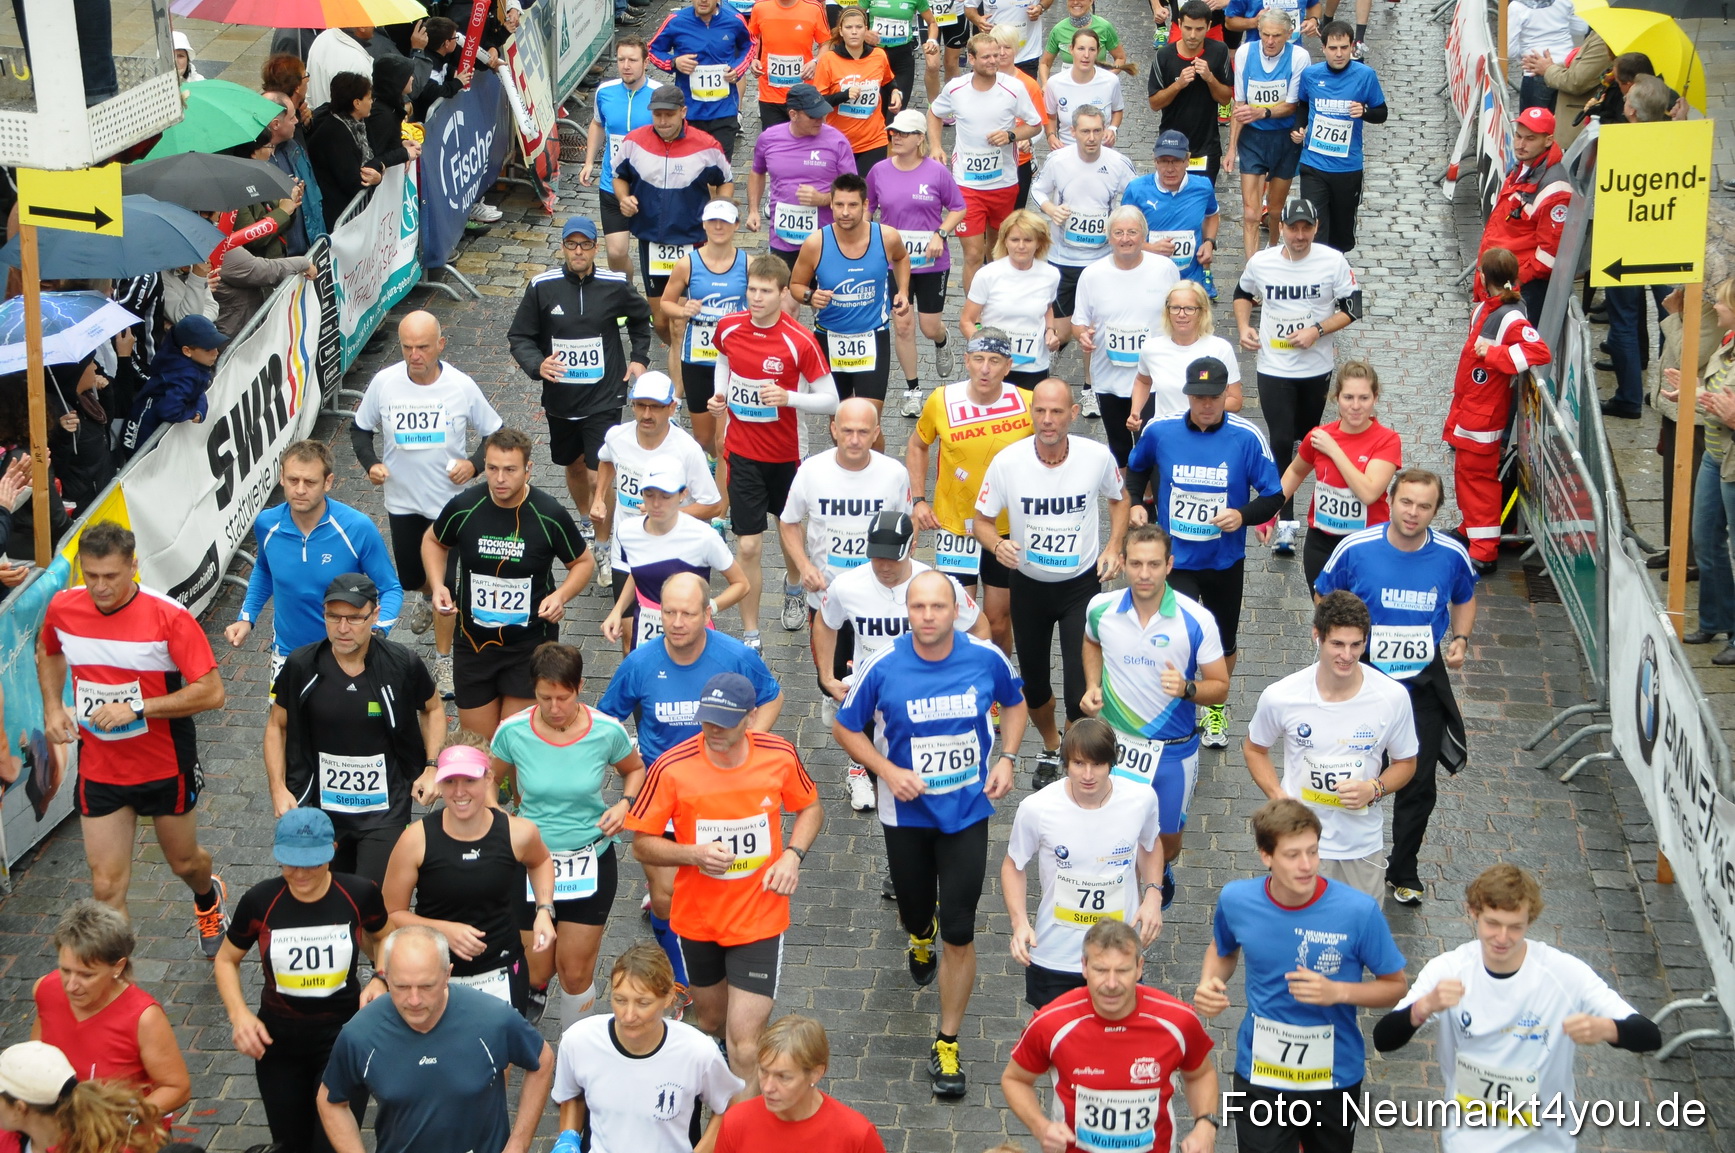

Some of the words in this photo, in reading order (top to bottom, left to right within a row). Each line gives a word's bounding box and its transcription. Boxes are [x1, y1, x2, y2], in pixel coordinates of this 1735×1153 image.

[876, 23, 905, 37] 2113
[465, 35, 476, 57] BKK
[771, 62, 801, 76] 2019
[698, 74, 722, 88] 113
[1254, 89, 1280, 104] 408
[1315, 125, 1348, 143] 2764
[966, 156, 999, 171] 2927
[1600, 165, 1706, 197] Jugend-
[1628, 196, 1677, 222] lauf
[778, 213, 814, 230] 2045
[1069, 217, 1105, 234] 2469
[658, 244, 685, 260] 326
[1265, 284, 1321, 300] THULE
[831, 298, 875, 308] Marathonteam
[837, 340, 867, 357] 346
[1108, 333, 1147, 350] 3116
[559, 349, 600, 367] 2849
[837, 359, 868, 367] Alexander
[569, 370, 589, 378] Mario
[731, 386, 767, 407] 264
[396, 411, 441, 430] 2037
[740, 407, 762, 418] Jürgen
[123, 420, 137, 449] NYC
[404, 433, 433, 443] Herbert
[950, 426, 987, 443] MAX
[991, 417, 1031, 437] BÖGL
[1172, 464, 1229, 481] HUBER
[1020, 493, 1087, 516] THULE
[1174, 500, 1219, 523] 2761
[1318, 494, 1363, 519] 2309
[1026, 523, 1044, 532] PARTL
[1178, 523, 1211, 535] Christian
[1327, 518, 1349, 529] Sarah
[478, 537, 526, 551] STOCKHOLM
[831, 536, 867, 555] 242
[936, 532, 977, 555] 2900
[1030, 533, 1078, 553] 2427
[478, 545, 524, 558] MARATHON
[942, 556, 961, 566] Peter
[1038, 555, 1067, 566] Richard
[472, 578, 491, 588] PARTL
[492, 581, 520, 590] Neumarkt
[476, 588, 526, 611] 3122
[1380, 587, 1438, 606] HUBER
[1376, 640, 1428, 660] 2763
[1122, 655, 1157, 668] Stefan
[77, 686, 96, 697] PARTL
[97, 688, 129, 698] Neumarkt
[905, 693, 978, 716] HUBER
[912, 742, 935, 750] PARTL
[936, 739, 969, 748] Neumarkt
[320, 757, 340, 768] PARTL
[341, 761, 374, 769] Neumarkt
[920, 747, 975, 774] 2769
[1320, 760, 1353, 770] Neumarkt
[326, 767, 380, 792] 2232
[929, 772, 968, 788] Bernhard
[1310, 770, 1352, 793] 567
[335, 793, 372, 806] Stephan
[697, 824, 721, 833] PARTL
[722, 822, 758, 833] Neumarkt
[1057, 874, 1080, 887] PARTL
[1081, 878, 1116, 888] Neumarkt
[1076, 888, 1106, 911] 78
[1073, 912, 1099, 924] Stefe
[272, 935, 299, 946] PARTL
[299, 932, 338, 943] Neumarkt
[288, 944, 335, 972] 201
[300, 977, 326, 988] Jutta
[1256, 1022, 1281, 1037] PARTL
[1282, 1029, 1320, 1040] Neumarkt
[1277, 1039, 1310, 1066] 77
[1457, 1059, 1482, 1076] PARTL
[1484, 1069, 1524, 1083] Neumarkt
[1077, 1091, 1105, 1104] PARTL
[1479, 1076, 1512, 1106] 76
[1083, 1103, 1152, 1132] 3013
[1090, 1134, 1141, 1149] Wolfgang
